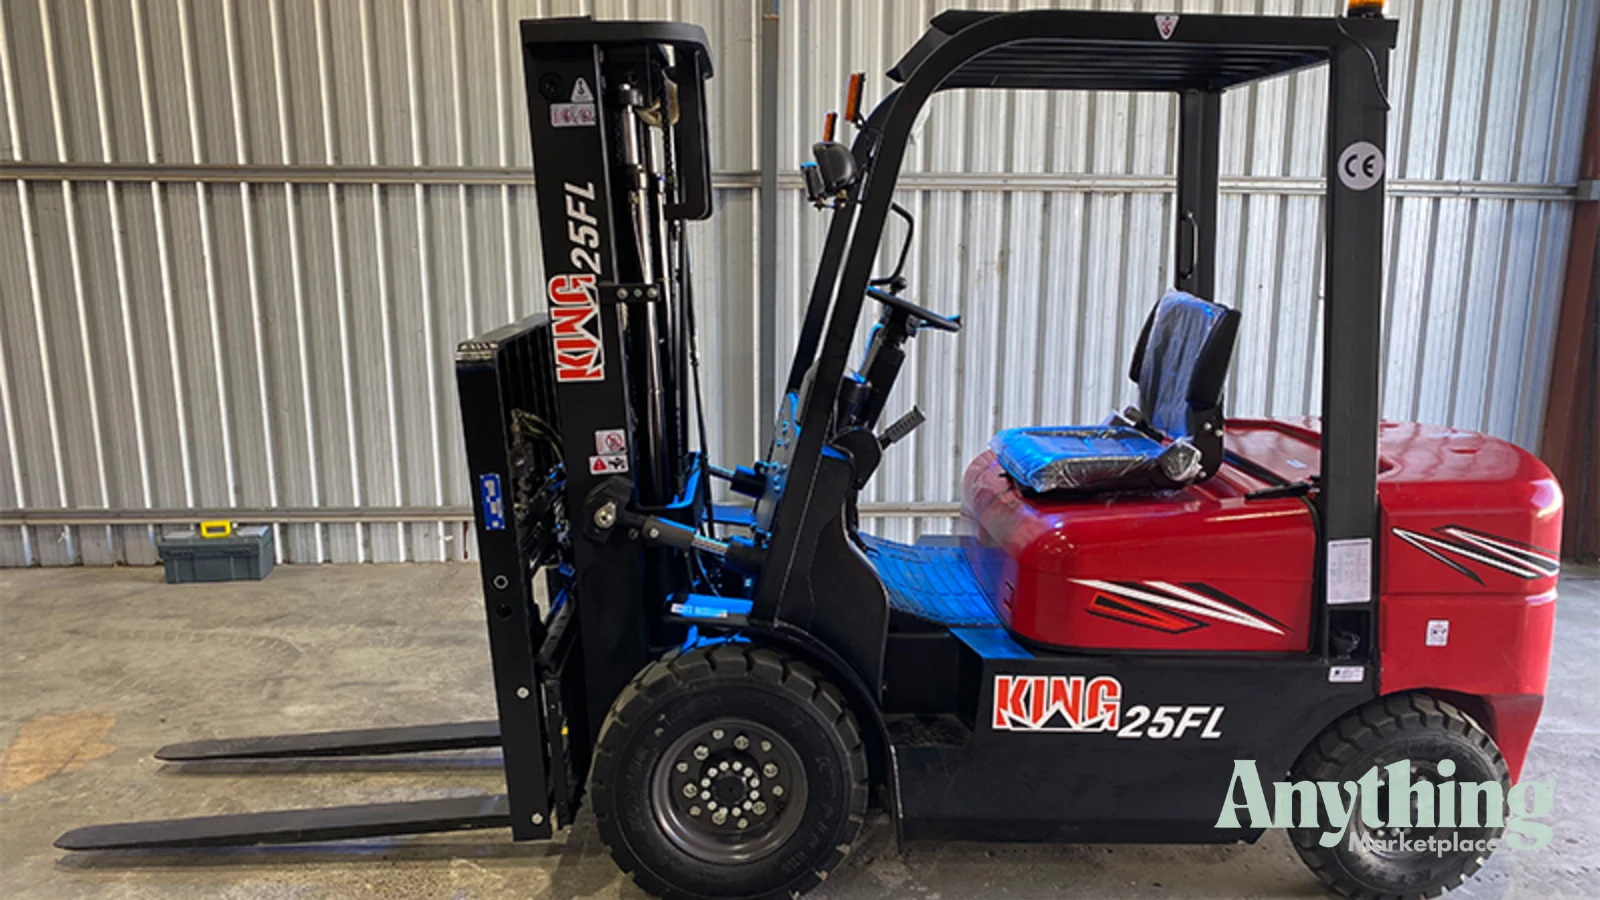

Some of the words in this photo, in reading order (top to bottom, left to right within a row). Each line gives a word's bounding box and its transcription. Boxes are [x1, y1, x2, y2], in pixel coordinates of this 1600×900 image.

[1345, 154, 1376, 178] CE
[564, 181, 602, 274] 25FL
[548, 274, 605, 382] KING
[992, 675, 1122, 731] KING
[1116, 705, 1225, 739] 25FL
